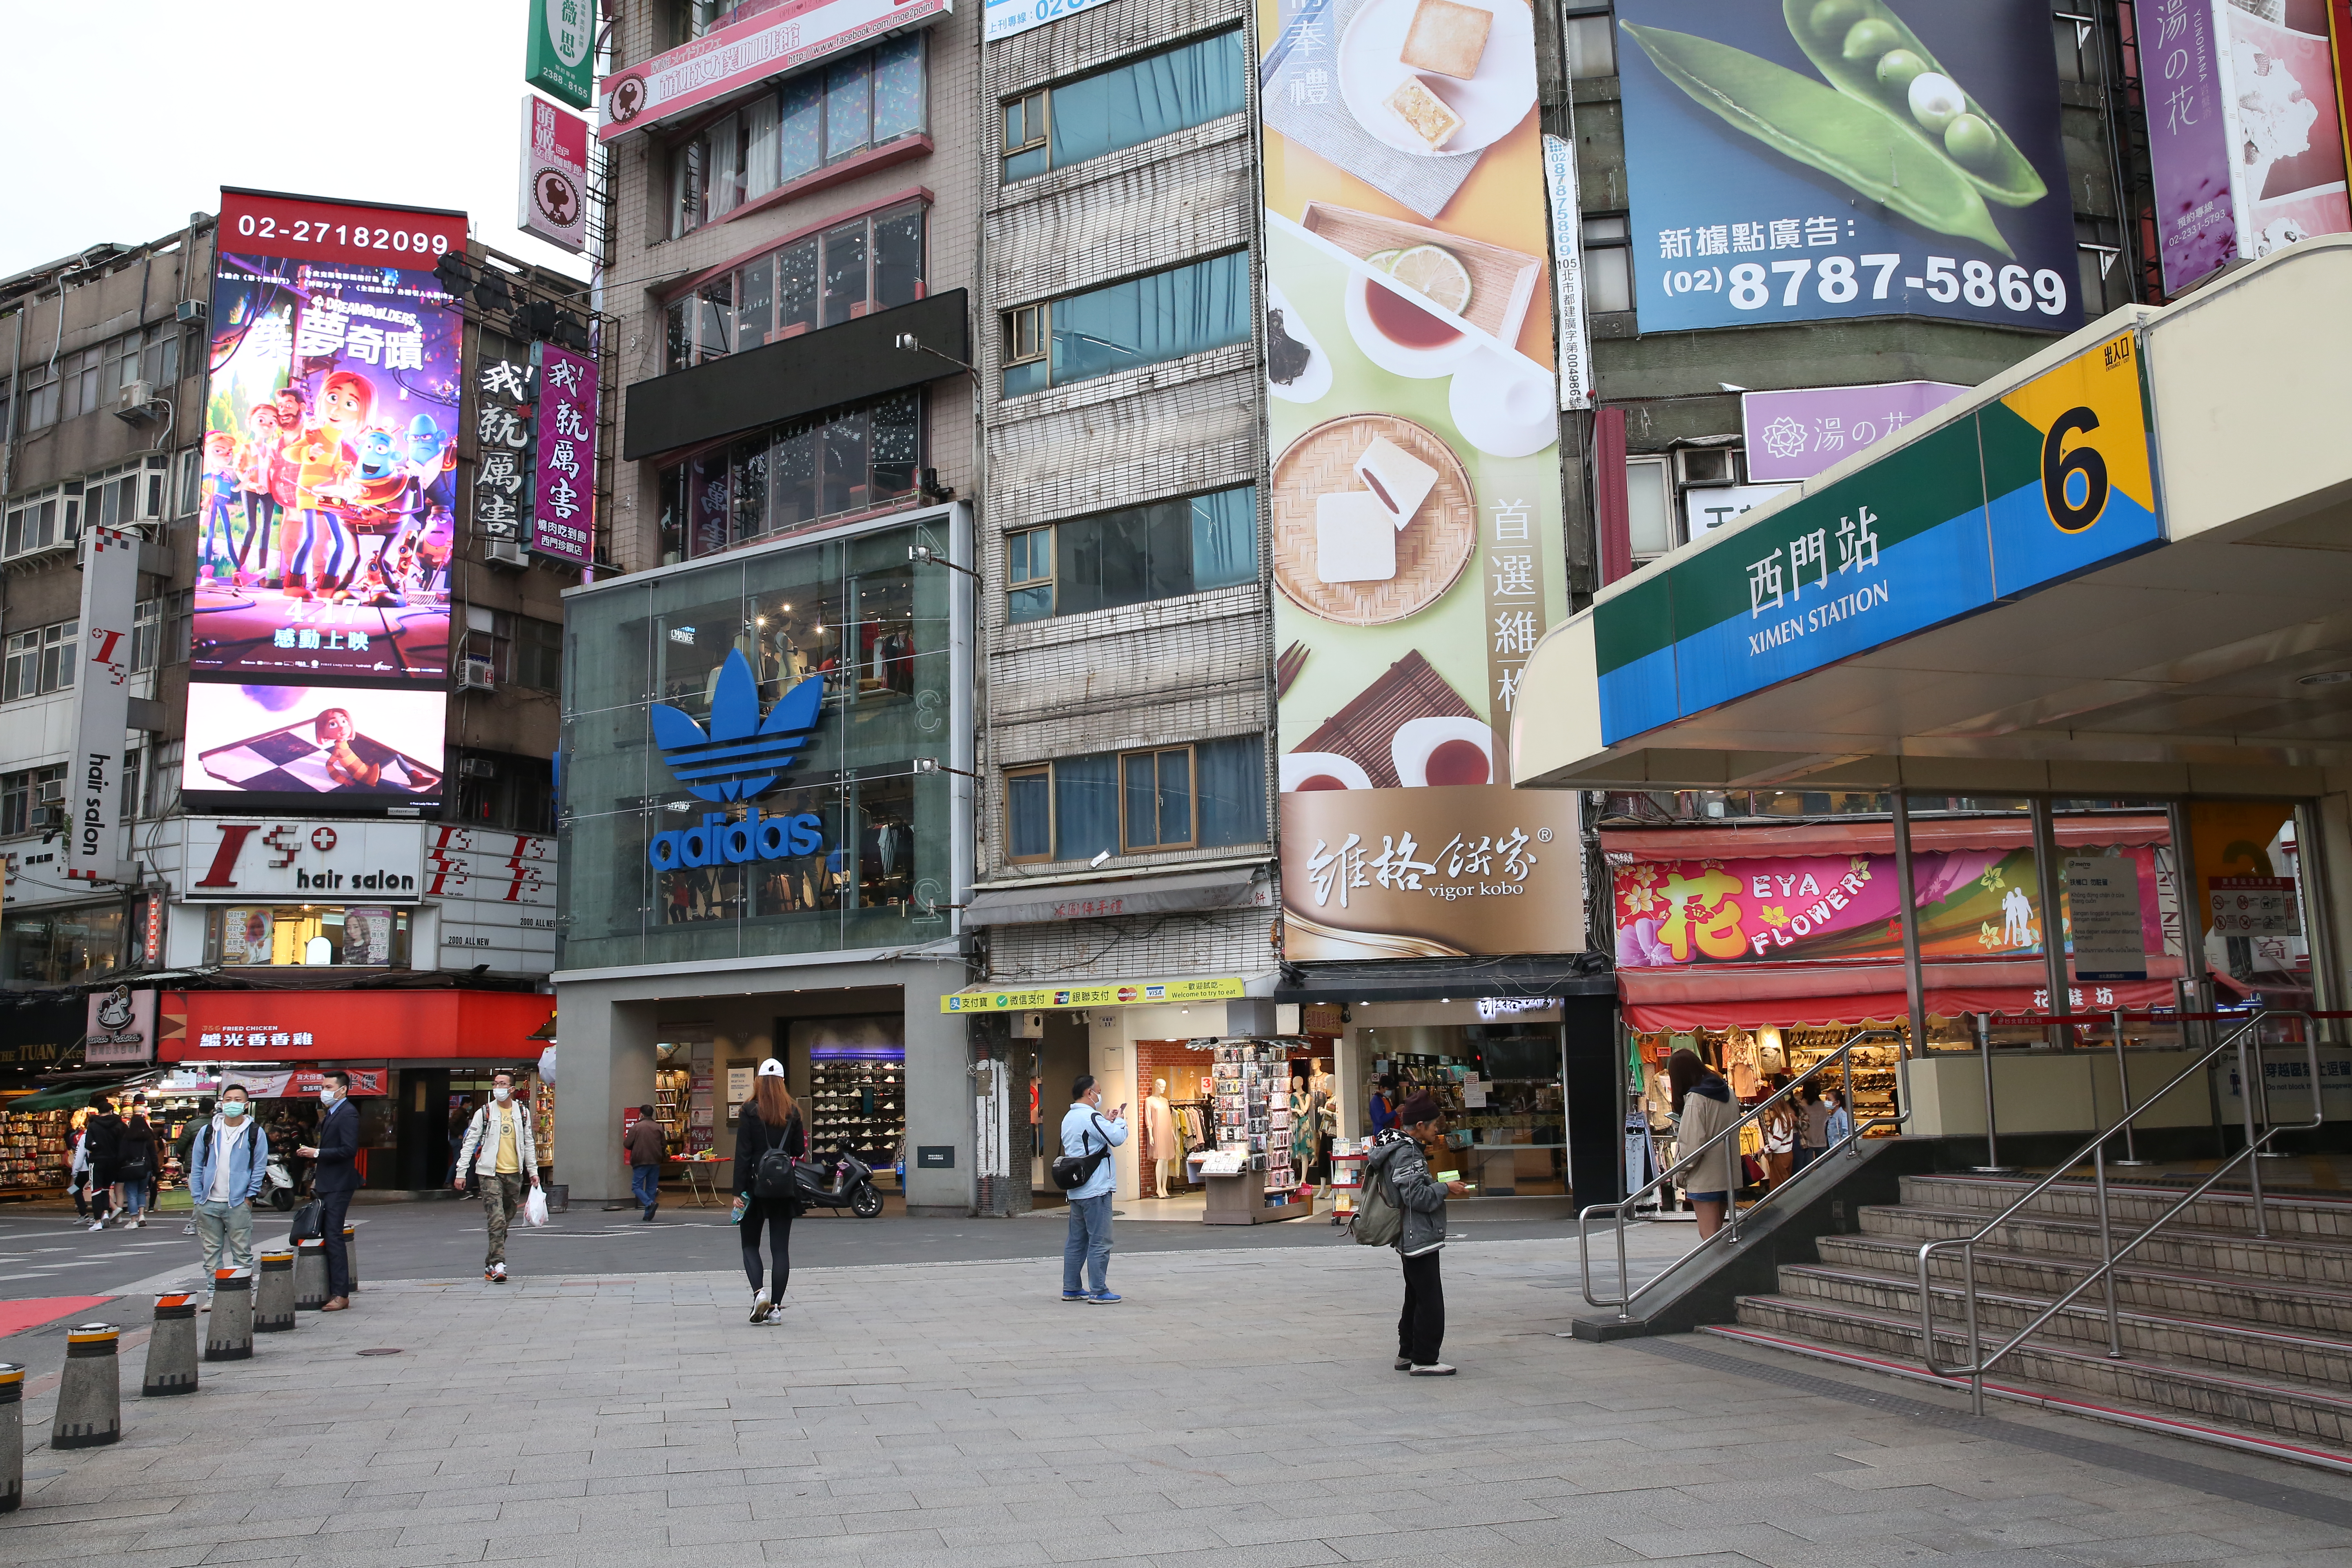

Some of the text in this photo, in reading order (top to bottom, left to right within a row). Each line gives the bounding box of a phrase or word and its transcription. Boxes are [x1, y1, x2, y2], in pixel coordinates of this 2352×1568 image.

[788, 2, 934, 65] http://www.facebook.com/moe2point
[2193, 9, 2208, 82] YUNOHANA
[659, 23, 800, 101] 萌姬女僕咖啡館
[1287, 0, 1329, 107] 奉禮
[2157, 0, 2198, 135] 湯の花
[543, 67, 588, 99] 2388-8155
[535, 102, 557, 154] 萌姬
[534, 146, 583, 177] 女僕咖啡館
[556, 144, 570, 156] 6F
[1548, 152, 1570, 163] (02)
[1553, 163, 1572, 256] 87875869
[2177, 201, 2214, 229] 預約專線
[238, 215, 449, 255] 02-27182099
[2168, 209, 2226, 247] 02-2331-5793
[1557, 258, 1577, 269] 105
[1663, 253, 2067, 316] (02) 8787-5869
[251, 302, 424, 371] 築夢奇蹟
[2104, 337, 2129, 367] 出入口
[2105, 361, 2121, 372] ENTRANCE
[2042, 405, 2110, 534] 6
[537, 518, 587, 544] 燒肉吃到飽
[541, 534, 583, 557] 西門珍饌店
[1746, 506, 1879, 619] 西門站
[285, 597, 361, 625] 4.17
[1748, 578, 1890, 658] XIMEN STATION
[273, 627, 370, 652] 感動上映
[671, 629, 695, 643] CHANGE
[87, 753, 111, 794] hair
[83, 798, 105, 856] salon
[649, 807, 823, 871] adidas
[296, 868, 414, 890] hair salon
[1307, 826, 1538, 909] 維格餅家
[1428, 881, 1524, 902] vigor kobo
[1753, 873, 1820, 898] EYA
[520, 918, 533, 926] 2000
[1657, 869, 1748, 961] 花
[1751, 872, 1865, 956] FLOWER
[448, 936, 489, 946] 2000 ALL NEW
[962, 997, 988, 1008] 支付寶
[1010, 994, 1045, 1006] 微信支付
[1072, 990, 1109, 1002] 銀聯支付
[19, 1044, 57, 1061] TUAN
[87, 1035, 109, 1044] uma
[199, 1031, 314, 1048] 繼光香香雞
[1203, 1078, 1211, 1088] 3
